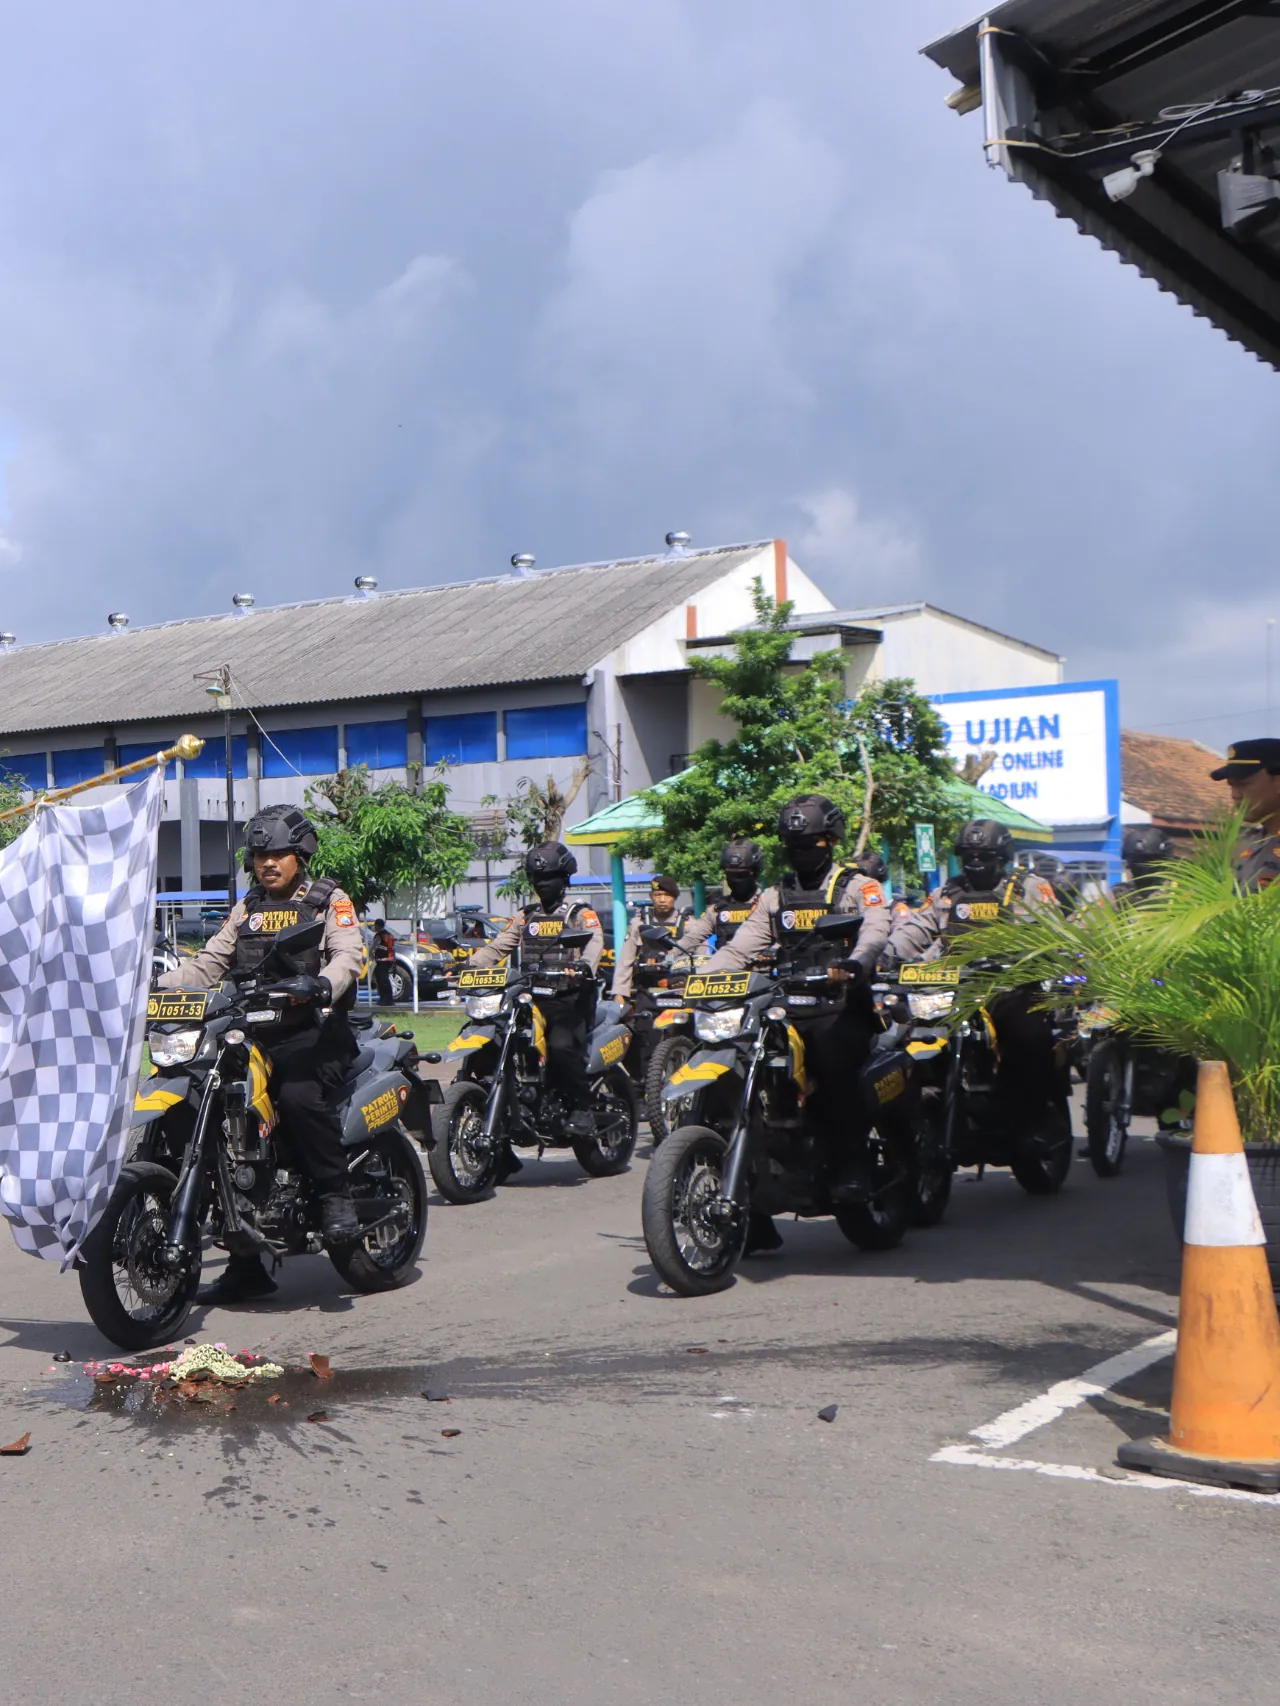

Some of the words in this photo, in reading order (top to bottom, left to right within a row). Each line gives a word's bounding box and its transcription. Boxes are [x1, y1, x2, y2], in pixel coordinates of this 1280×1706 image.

[966, 714, 1060, 745] UJIAN
[1002, 749, 1064, 772] ONLINE
[979, 781, 1038, 800] ADIUN
[263, 911, 298, 920] PATROLI
[475, 976, 504, 985] 1053-53
[707, 984, 746, 994] 1052-53
[161, 1005, 203, 1016] 1051-53
[361, 1088, 397, 1116] PATROLI
[365, 1096, 398, 1125] PERINTIS
